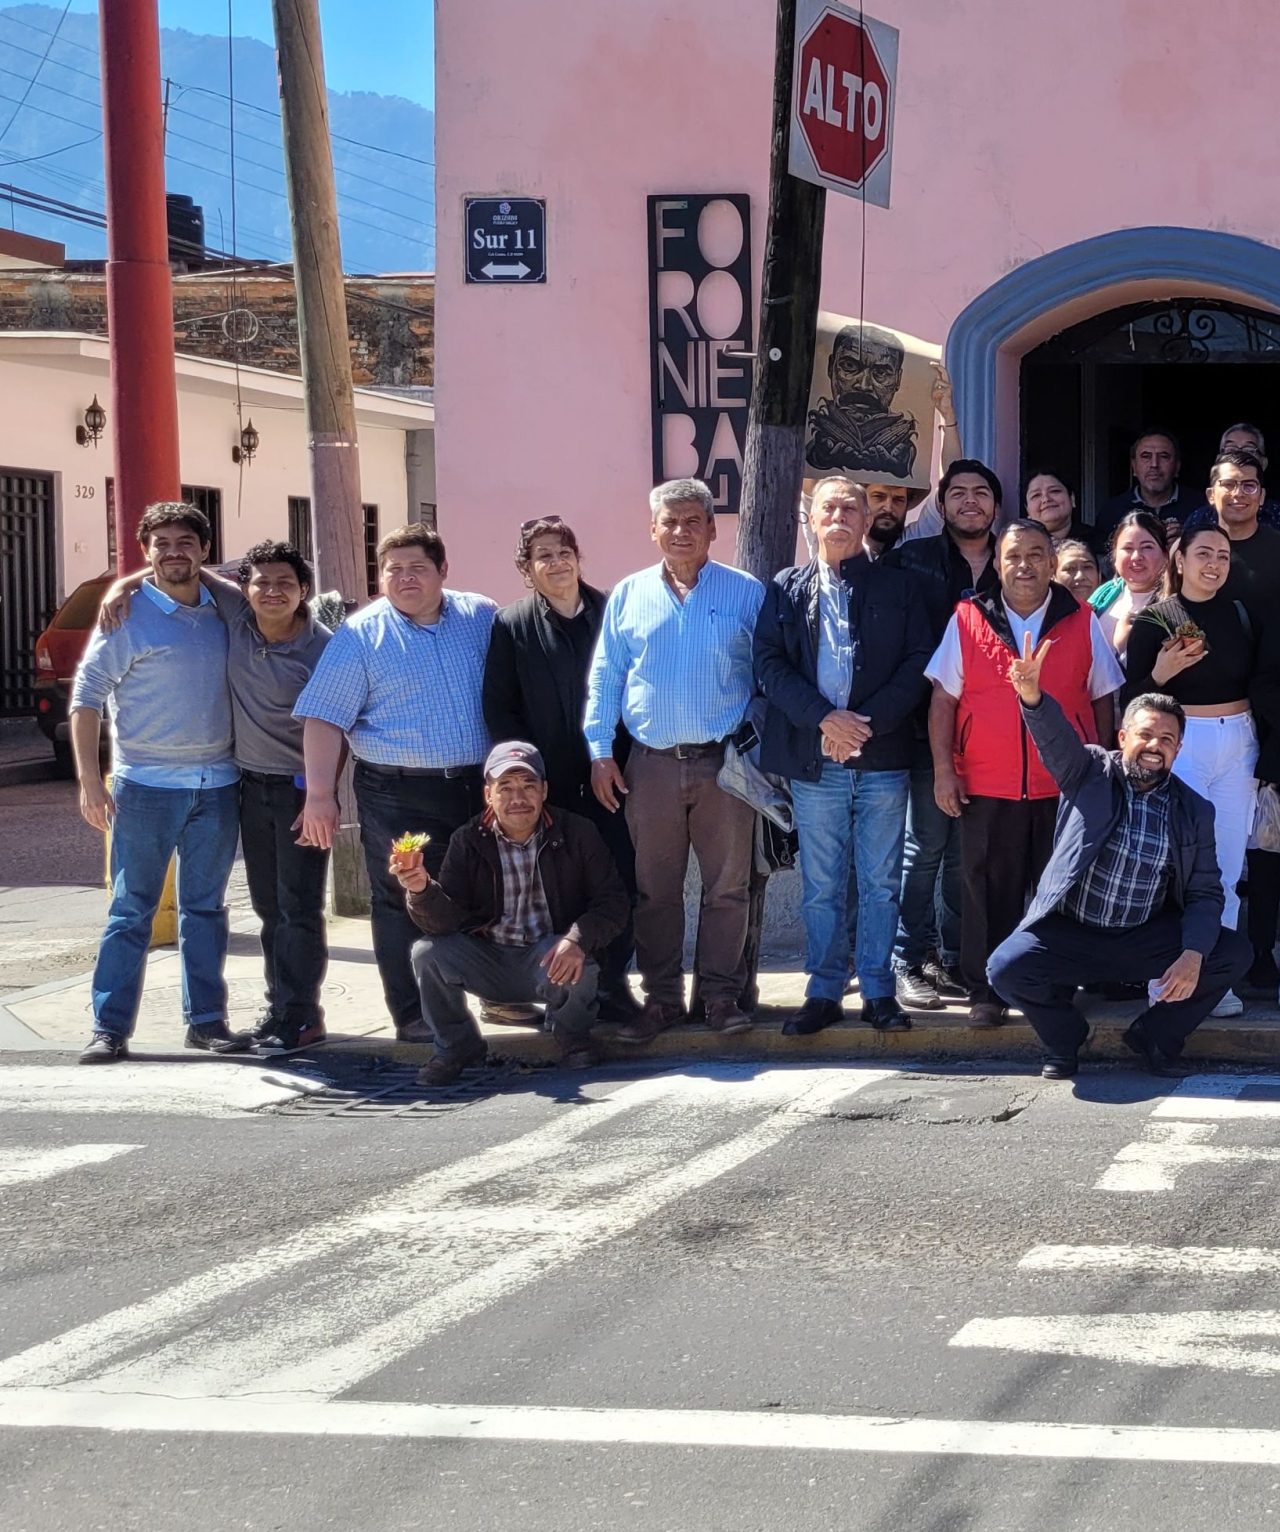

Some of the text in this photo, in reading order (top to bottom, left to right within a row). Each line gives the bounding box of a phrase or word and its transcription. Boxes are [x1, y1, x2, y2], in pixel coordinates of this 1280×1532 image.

[803, 57, 883, 141] ALTO
[473, 228, 537, 249] Sur 11
[74, 484, 95, 500] 329
